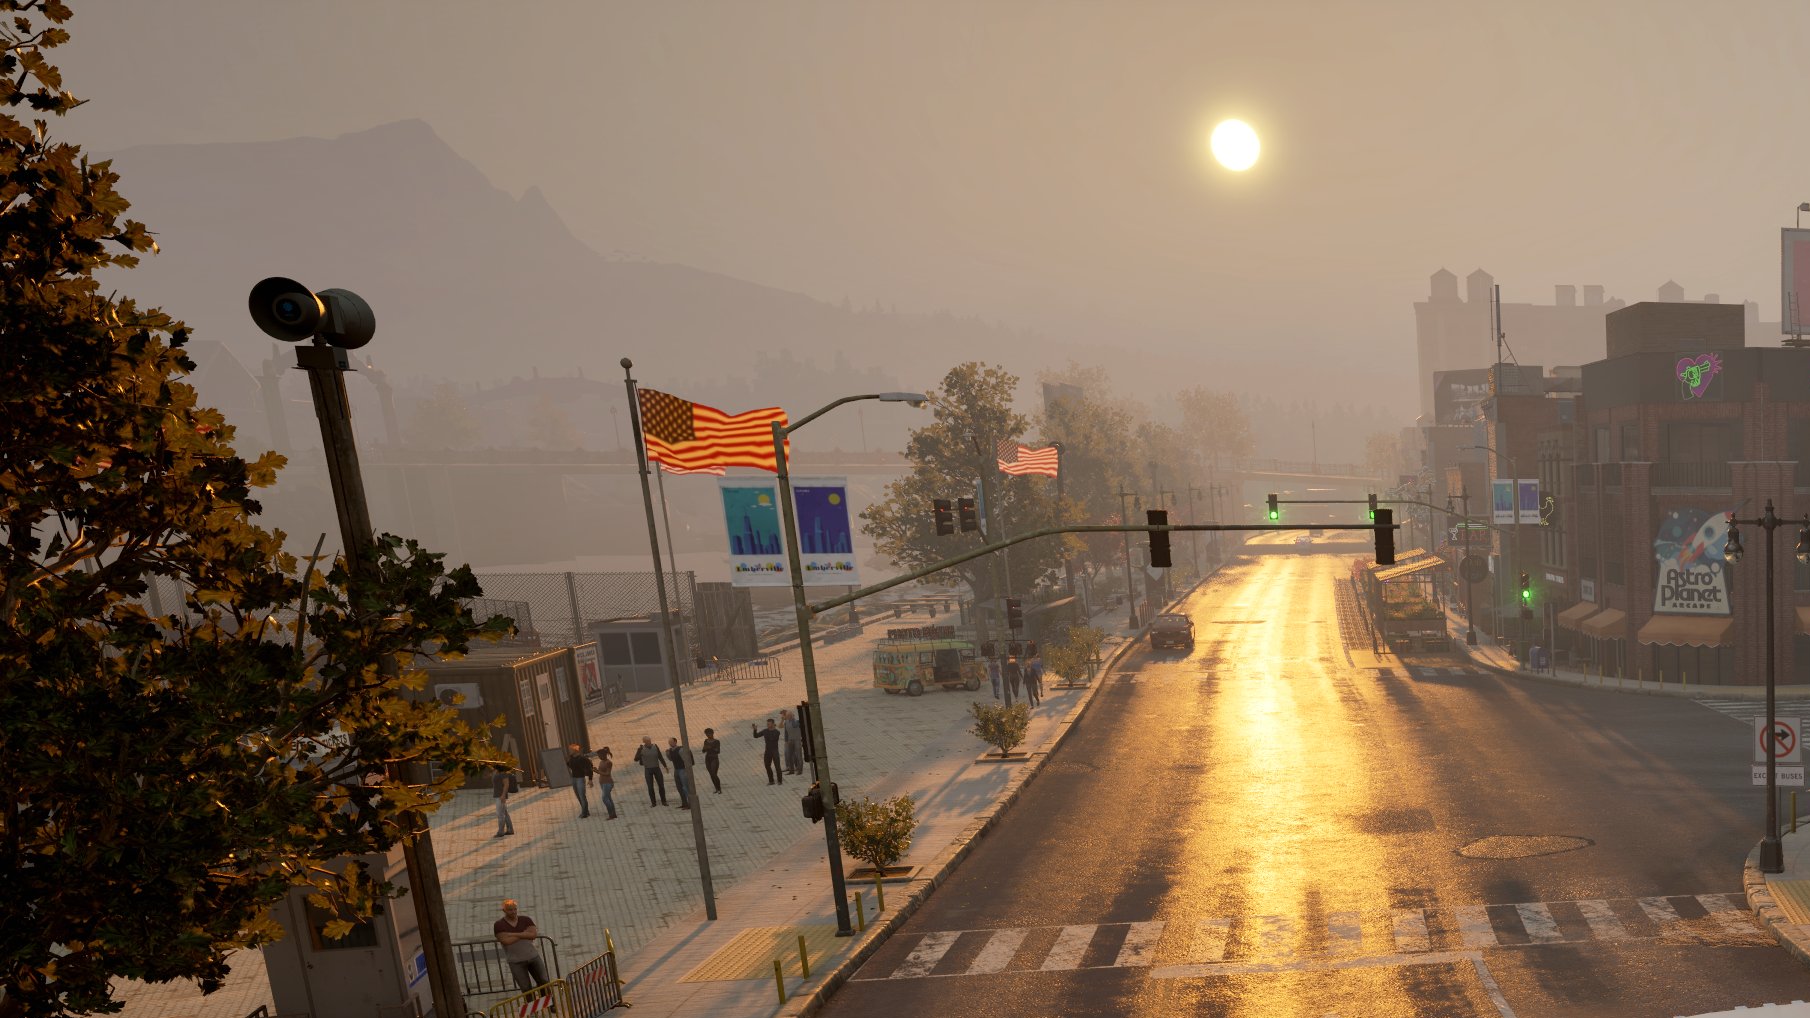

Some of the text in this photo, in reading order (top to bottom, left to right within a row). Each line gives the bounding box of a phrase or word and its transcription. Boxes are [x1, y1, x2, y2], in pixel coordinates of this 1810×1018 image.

[1666, 568, 1713, 588] Astro
[1753, 772, 1803, 780] EXCT BUSES
